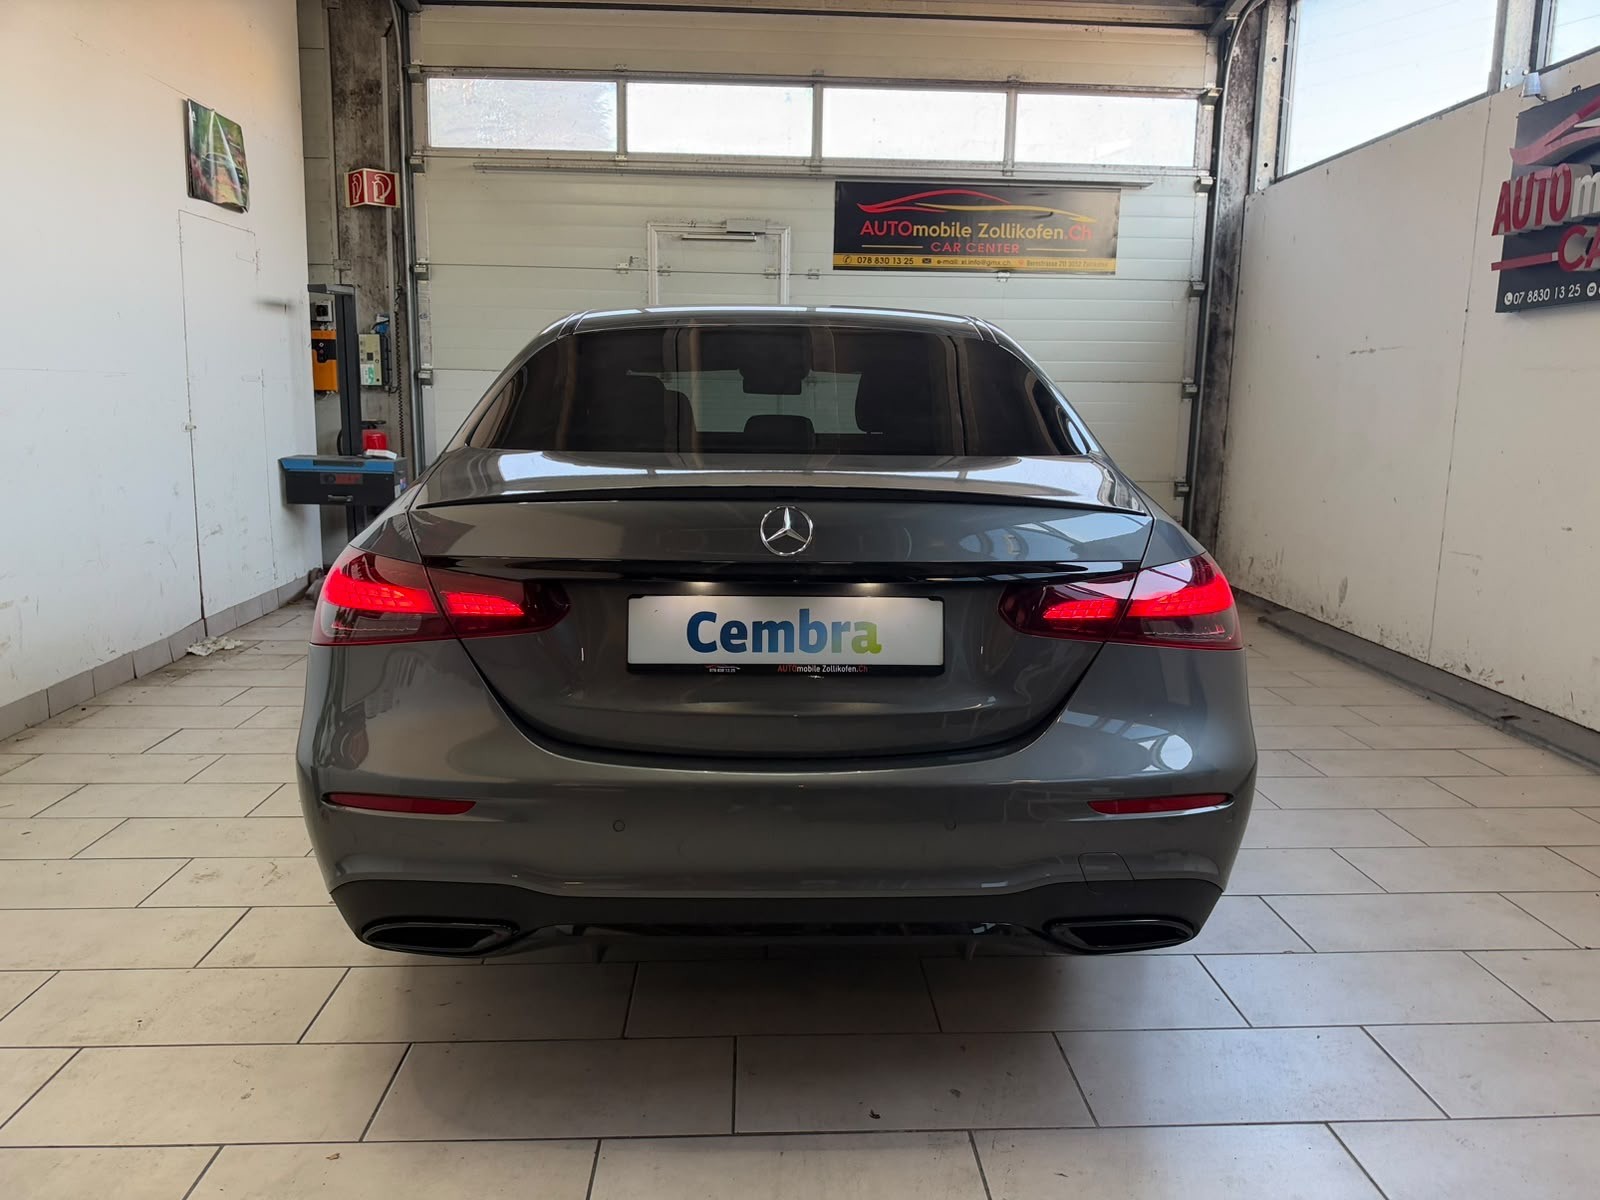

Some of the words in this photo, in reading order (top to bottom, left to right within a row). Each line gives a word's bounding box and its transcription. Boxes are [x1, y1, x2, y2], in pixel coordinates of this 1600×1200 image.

[860, 220, 972, 238] AUTOmobile
[978, 222, 1093, 241] Zollikofen.Ch
[930, 242, 960, 252] CAR
[966, 242, 1020, 254] CENTER
[857, 256, 872, 264] 078
[874, 256, 889, 265] 830
[893, 257, 902, 265] 13
[904, 257, 914, 265] 25
[1513, 292, 1525, 304] 07
[1527, 288, 1550, 303] 8830
[1554, 286, 1565, 299] 13
[1568, 284, 1581, 297] 25
[686, 608, 882, 654] Cembra
[778, 665, 820, 673] AUTOmobile
[822, 665, 868, 673] Zollikofen.Ch
